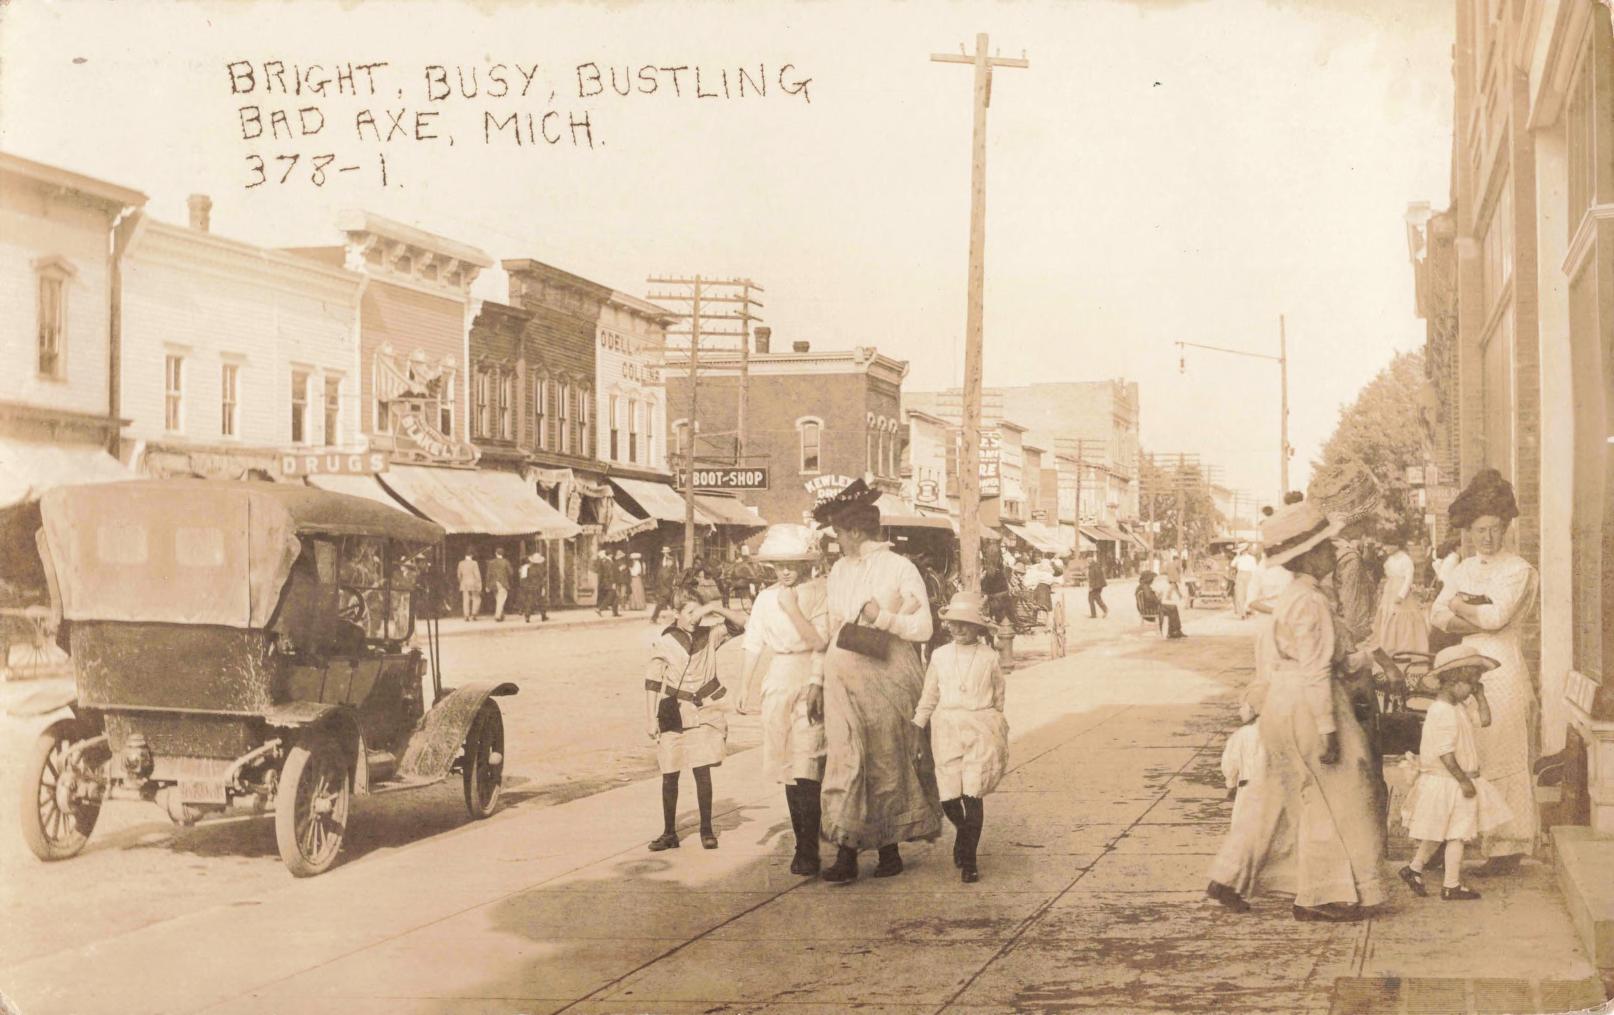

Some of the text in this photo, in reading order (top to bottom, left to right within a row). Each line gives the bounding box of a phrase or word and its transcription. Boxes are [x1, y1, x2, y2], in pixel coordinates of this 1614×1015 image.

[600, 329, 633, 357] ODELL
[282, 453, 384, 474] DRUGS
[692, 471, 764, 487] BOOT-SHOP
